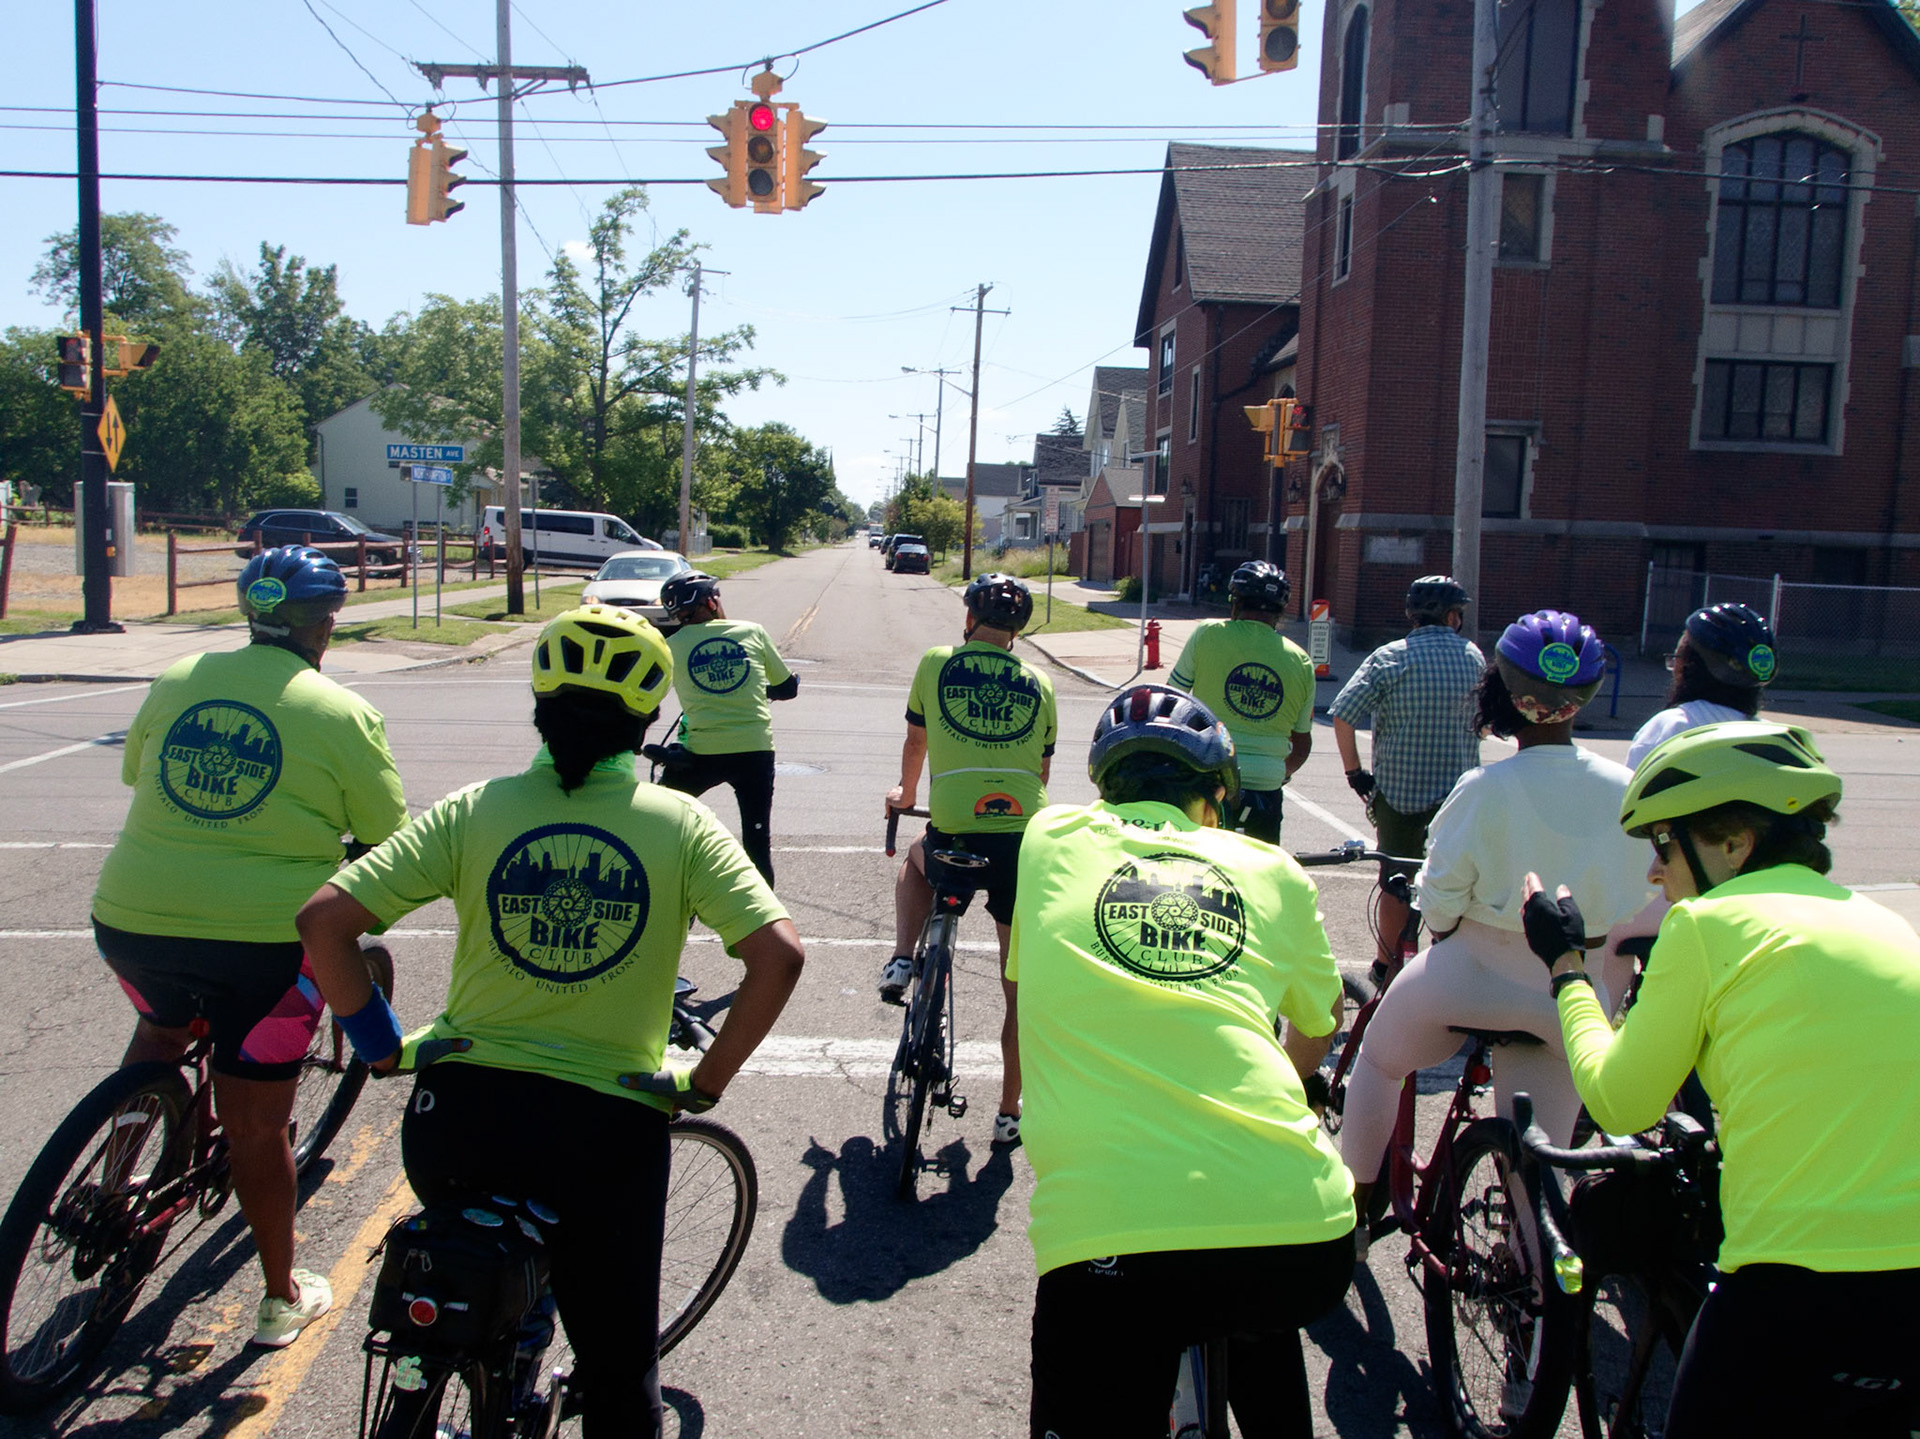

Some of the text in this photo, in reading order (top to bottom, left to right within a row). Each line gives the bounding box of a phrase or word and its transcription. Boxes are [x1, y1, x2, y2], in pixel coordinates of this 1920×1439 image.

[390, 446, 460, 459] MASTEN AVE
[708, 668, 735, 682] BIKE
[946, 688, 1034, 709] EAST SIDE
[1240, 693, 1266, 708] BIKE
[968, 700, 1014, 722] BIKE
[969, 718, 1012, 731] CLUB
[975, 741, 1010, 750] UNITED
[168, 746, 267, 780] EAST SIDE
[185, 764, 240, 796] BIKE
[184, 788, 232, 807] CLUB
[184, 814, 228, 829] UNITED
[502, 896, 634, 922] EAST SIDE
[1108, 904, 1234, 937] EAST SIDE
[530, 915, 600, 950] BIKE
[1140, 921, 1206, 952] BIKE
[529, 948, 592, 964] CLUB
[1140, 950, 1204, 964] CLUB
[487, 939, 641, 995] BUFFALO UNITED FRONT
[1150, 980, 1202, 992] NITD
[1212, 968, 1240, 988] FRON
